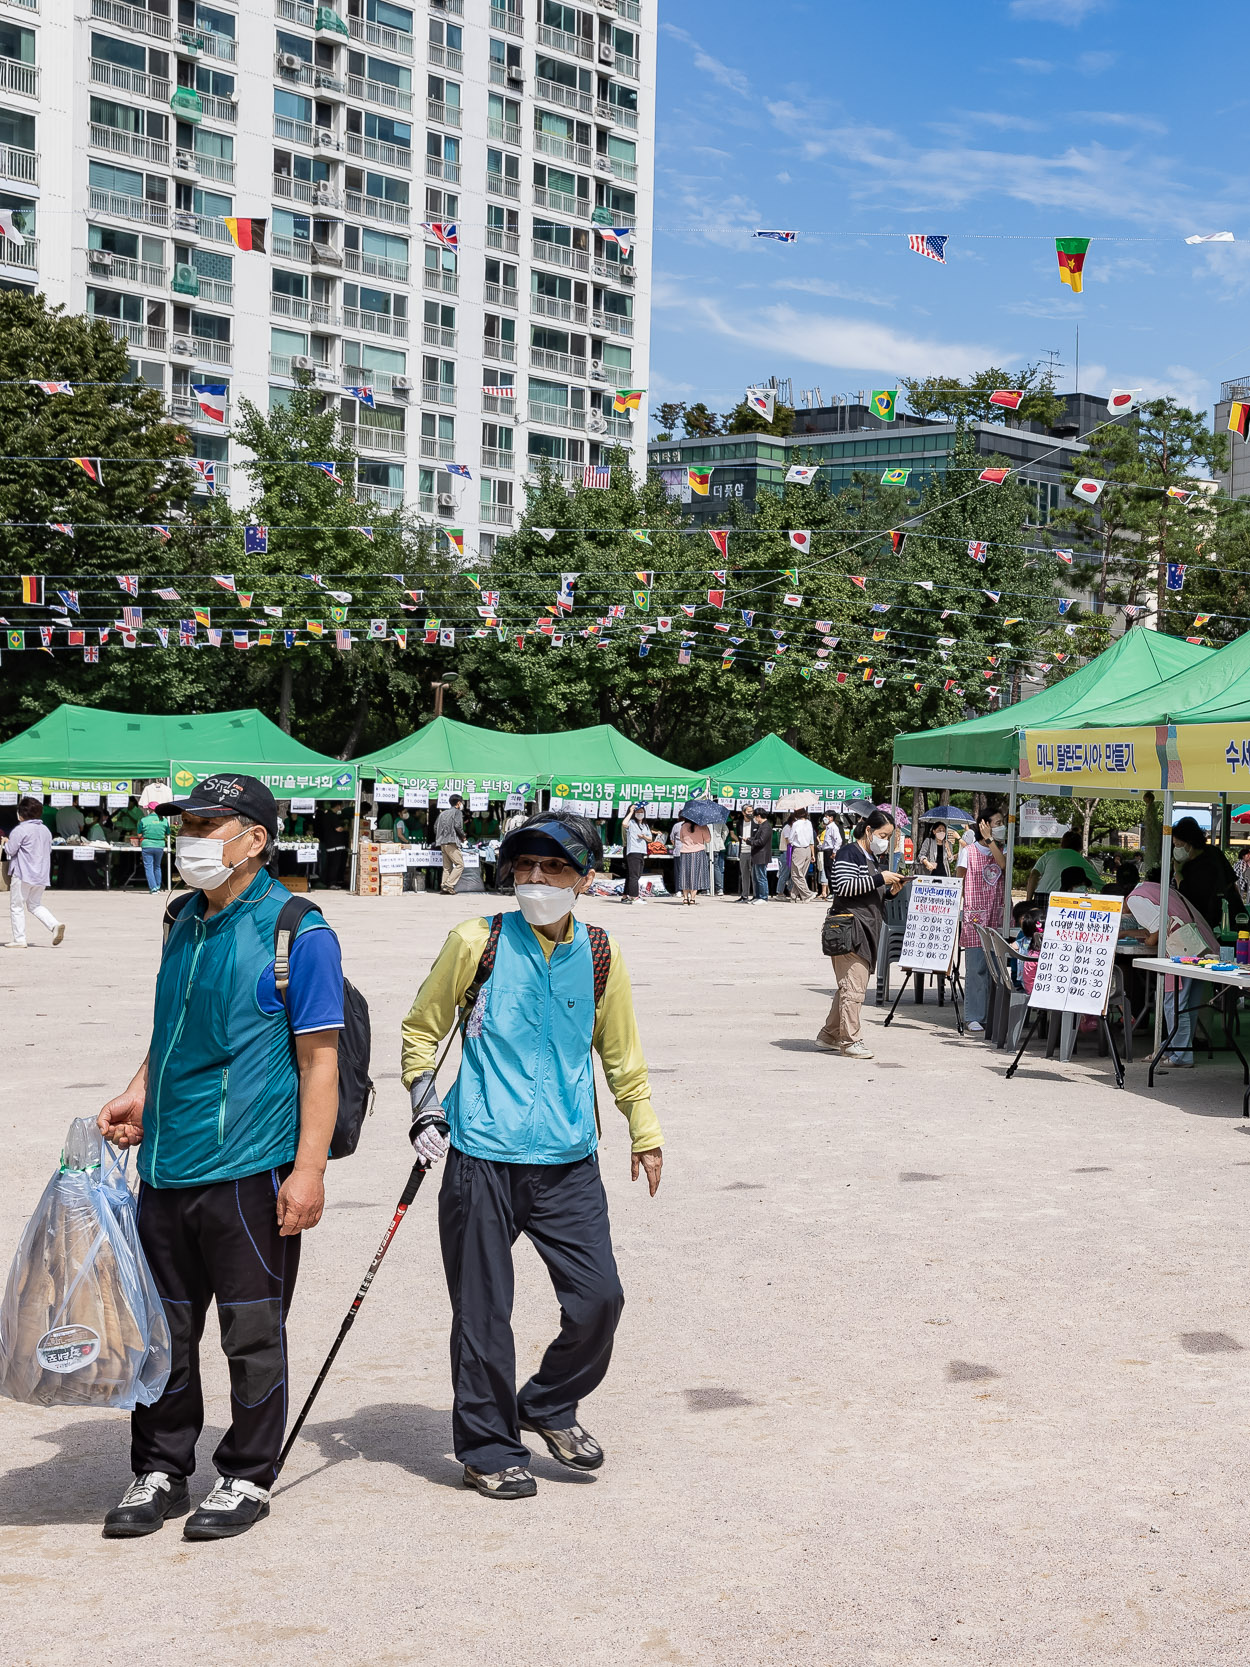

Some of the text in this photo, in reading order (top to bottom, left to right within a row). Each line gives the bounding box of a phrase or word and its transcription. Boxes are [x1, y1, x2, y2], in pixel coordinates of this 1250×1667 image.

[1036, 743, 1054, 772] 미니
[1105, 743, 1137, 773] 만들기
[18, 779, 113, 792] 능동 새마을부녀회
[260, 776, 333, 789] 새마을부녀회
[399, 778, 513, 793] 구의2동 새마을 부녀회
[571, 783, 689, 800] 구의3동 새마을부녀회
[738, 787, 772, 798] 광장동
[1059, 908, 1111, 923] 수세미 만들기
